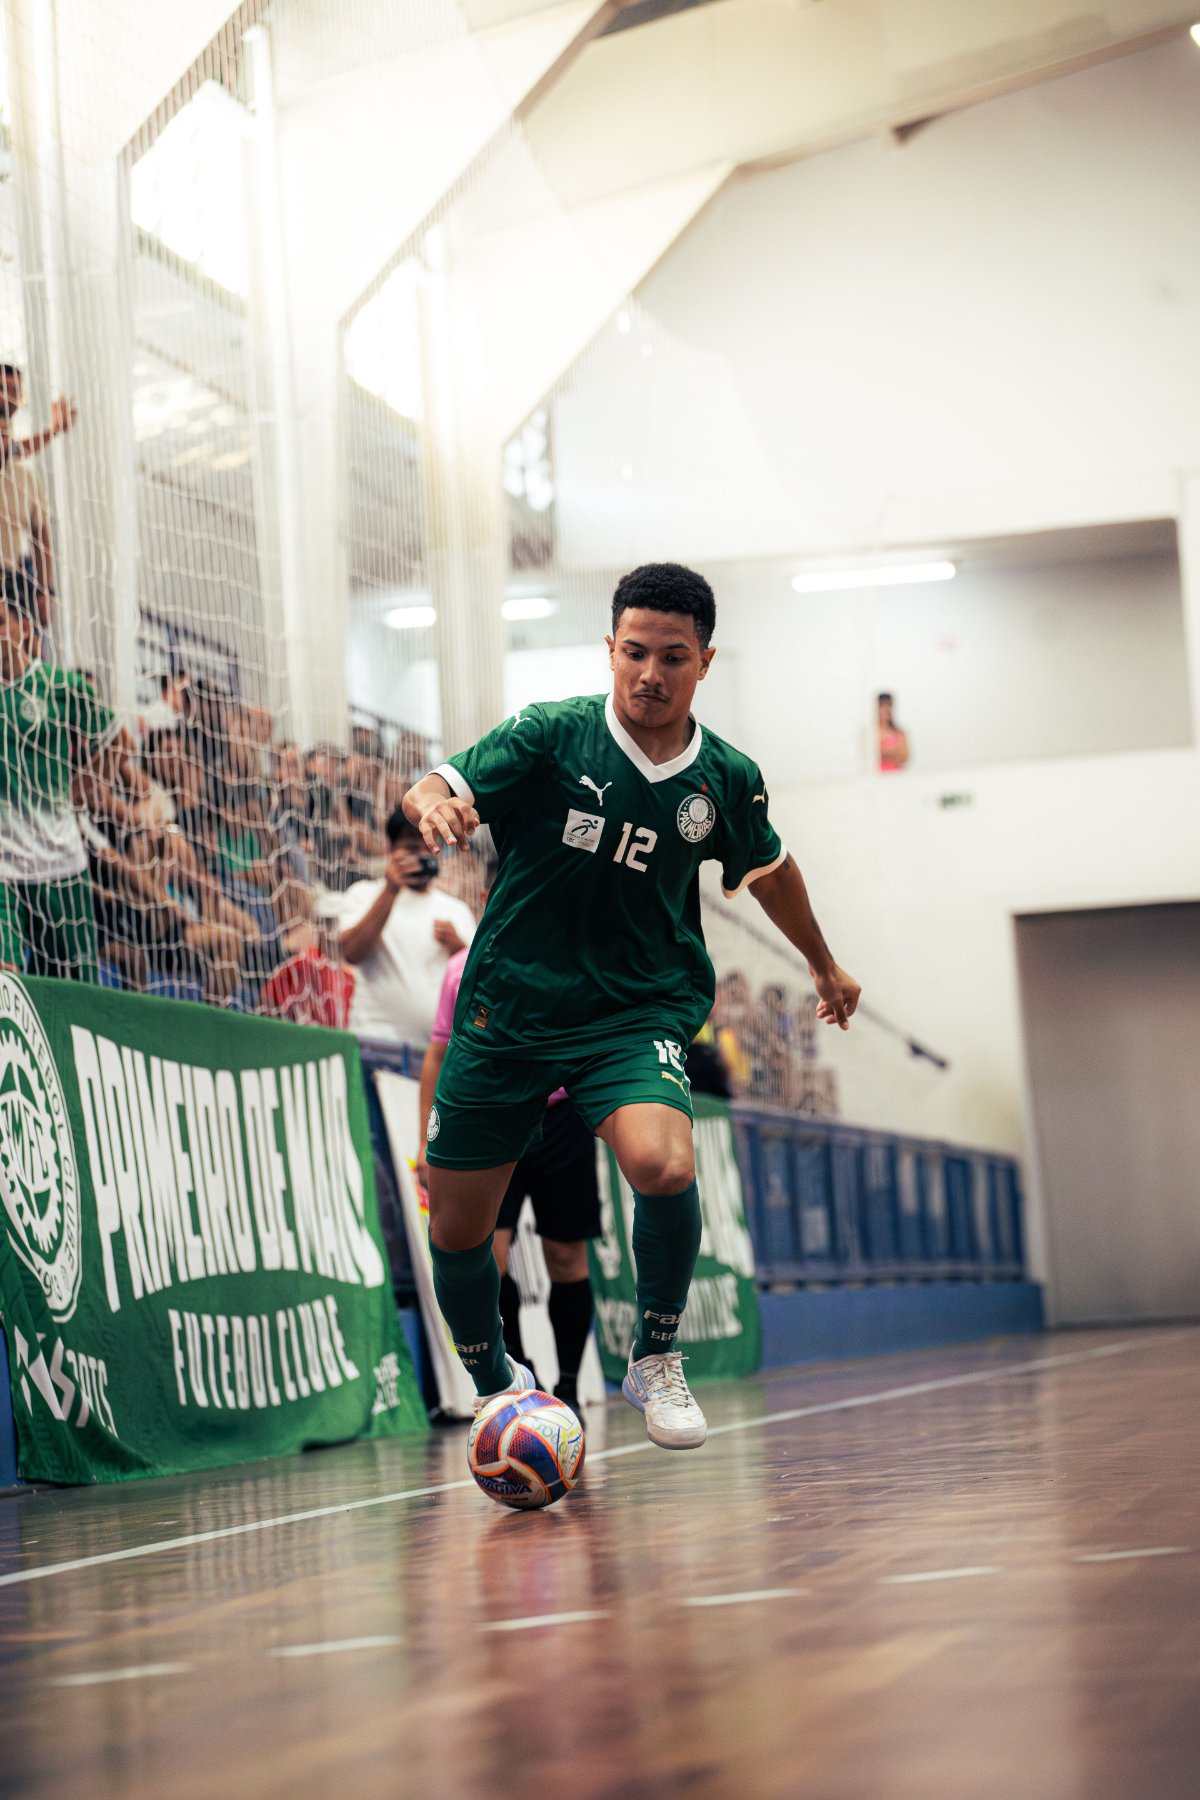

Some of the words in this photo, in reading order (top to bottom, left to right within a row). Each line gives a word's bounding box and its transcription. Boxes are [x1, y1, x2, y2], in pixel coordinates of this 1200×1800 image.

[613, 821, 658, 873] 12
[680, 811, 712, 839] PALMEIRAS
[14, 992, 65, 1139] FUTEBOL
[70, 1024, 256, 1313] PRIMEIRO
[240, 1066, 299, 1271] DE
[167, 1308, 282, 1410] FUTEBOL
[275, 1294, 361, 1401] CLUBE
